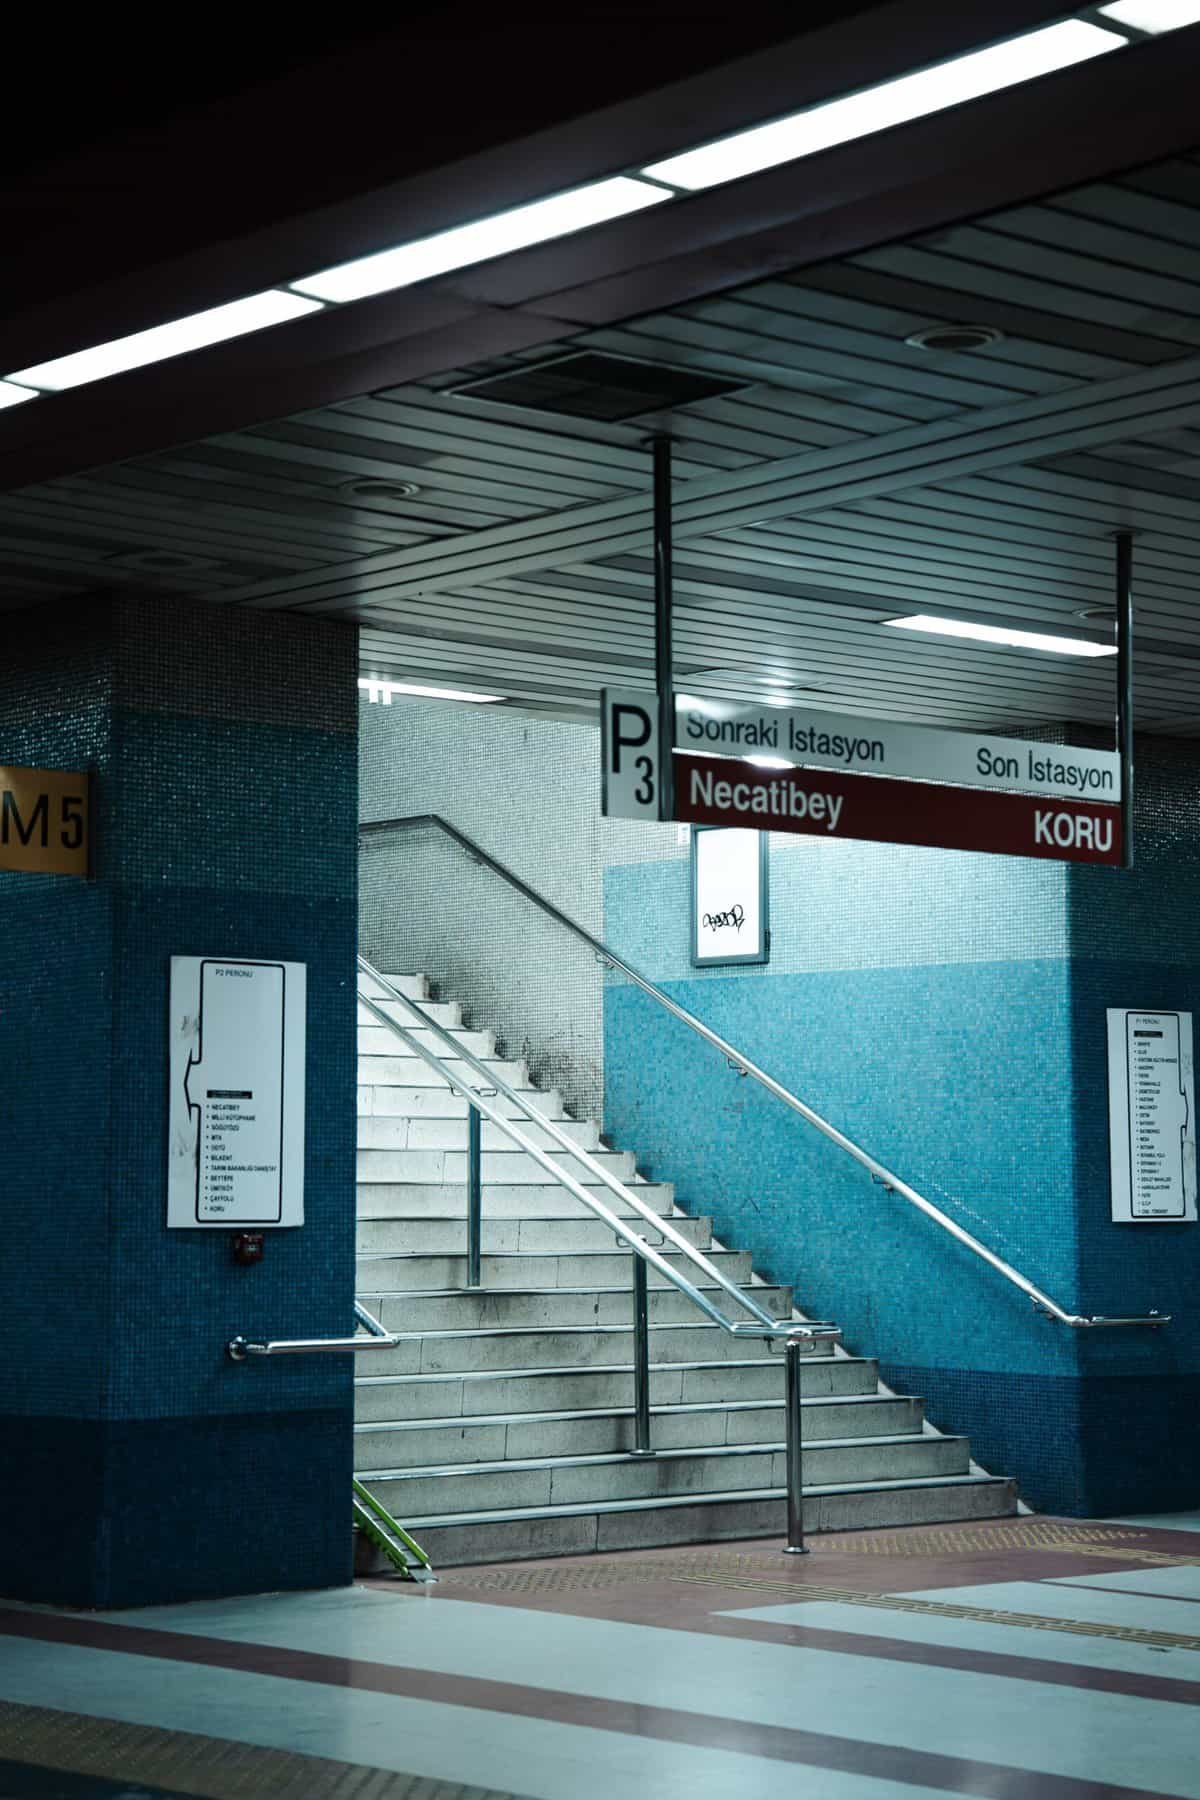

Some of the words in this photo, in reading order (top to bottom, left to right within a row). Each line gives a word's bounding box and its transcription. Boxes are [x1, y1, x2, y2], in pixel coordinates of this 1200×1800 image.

[686, 714, 779, 749] Sonraki
[976, 747, 1019, 779] Son
[690, 768, 844, 831] Necatibey
[1034, 810, 1113, 852] KORU
